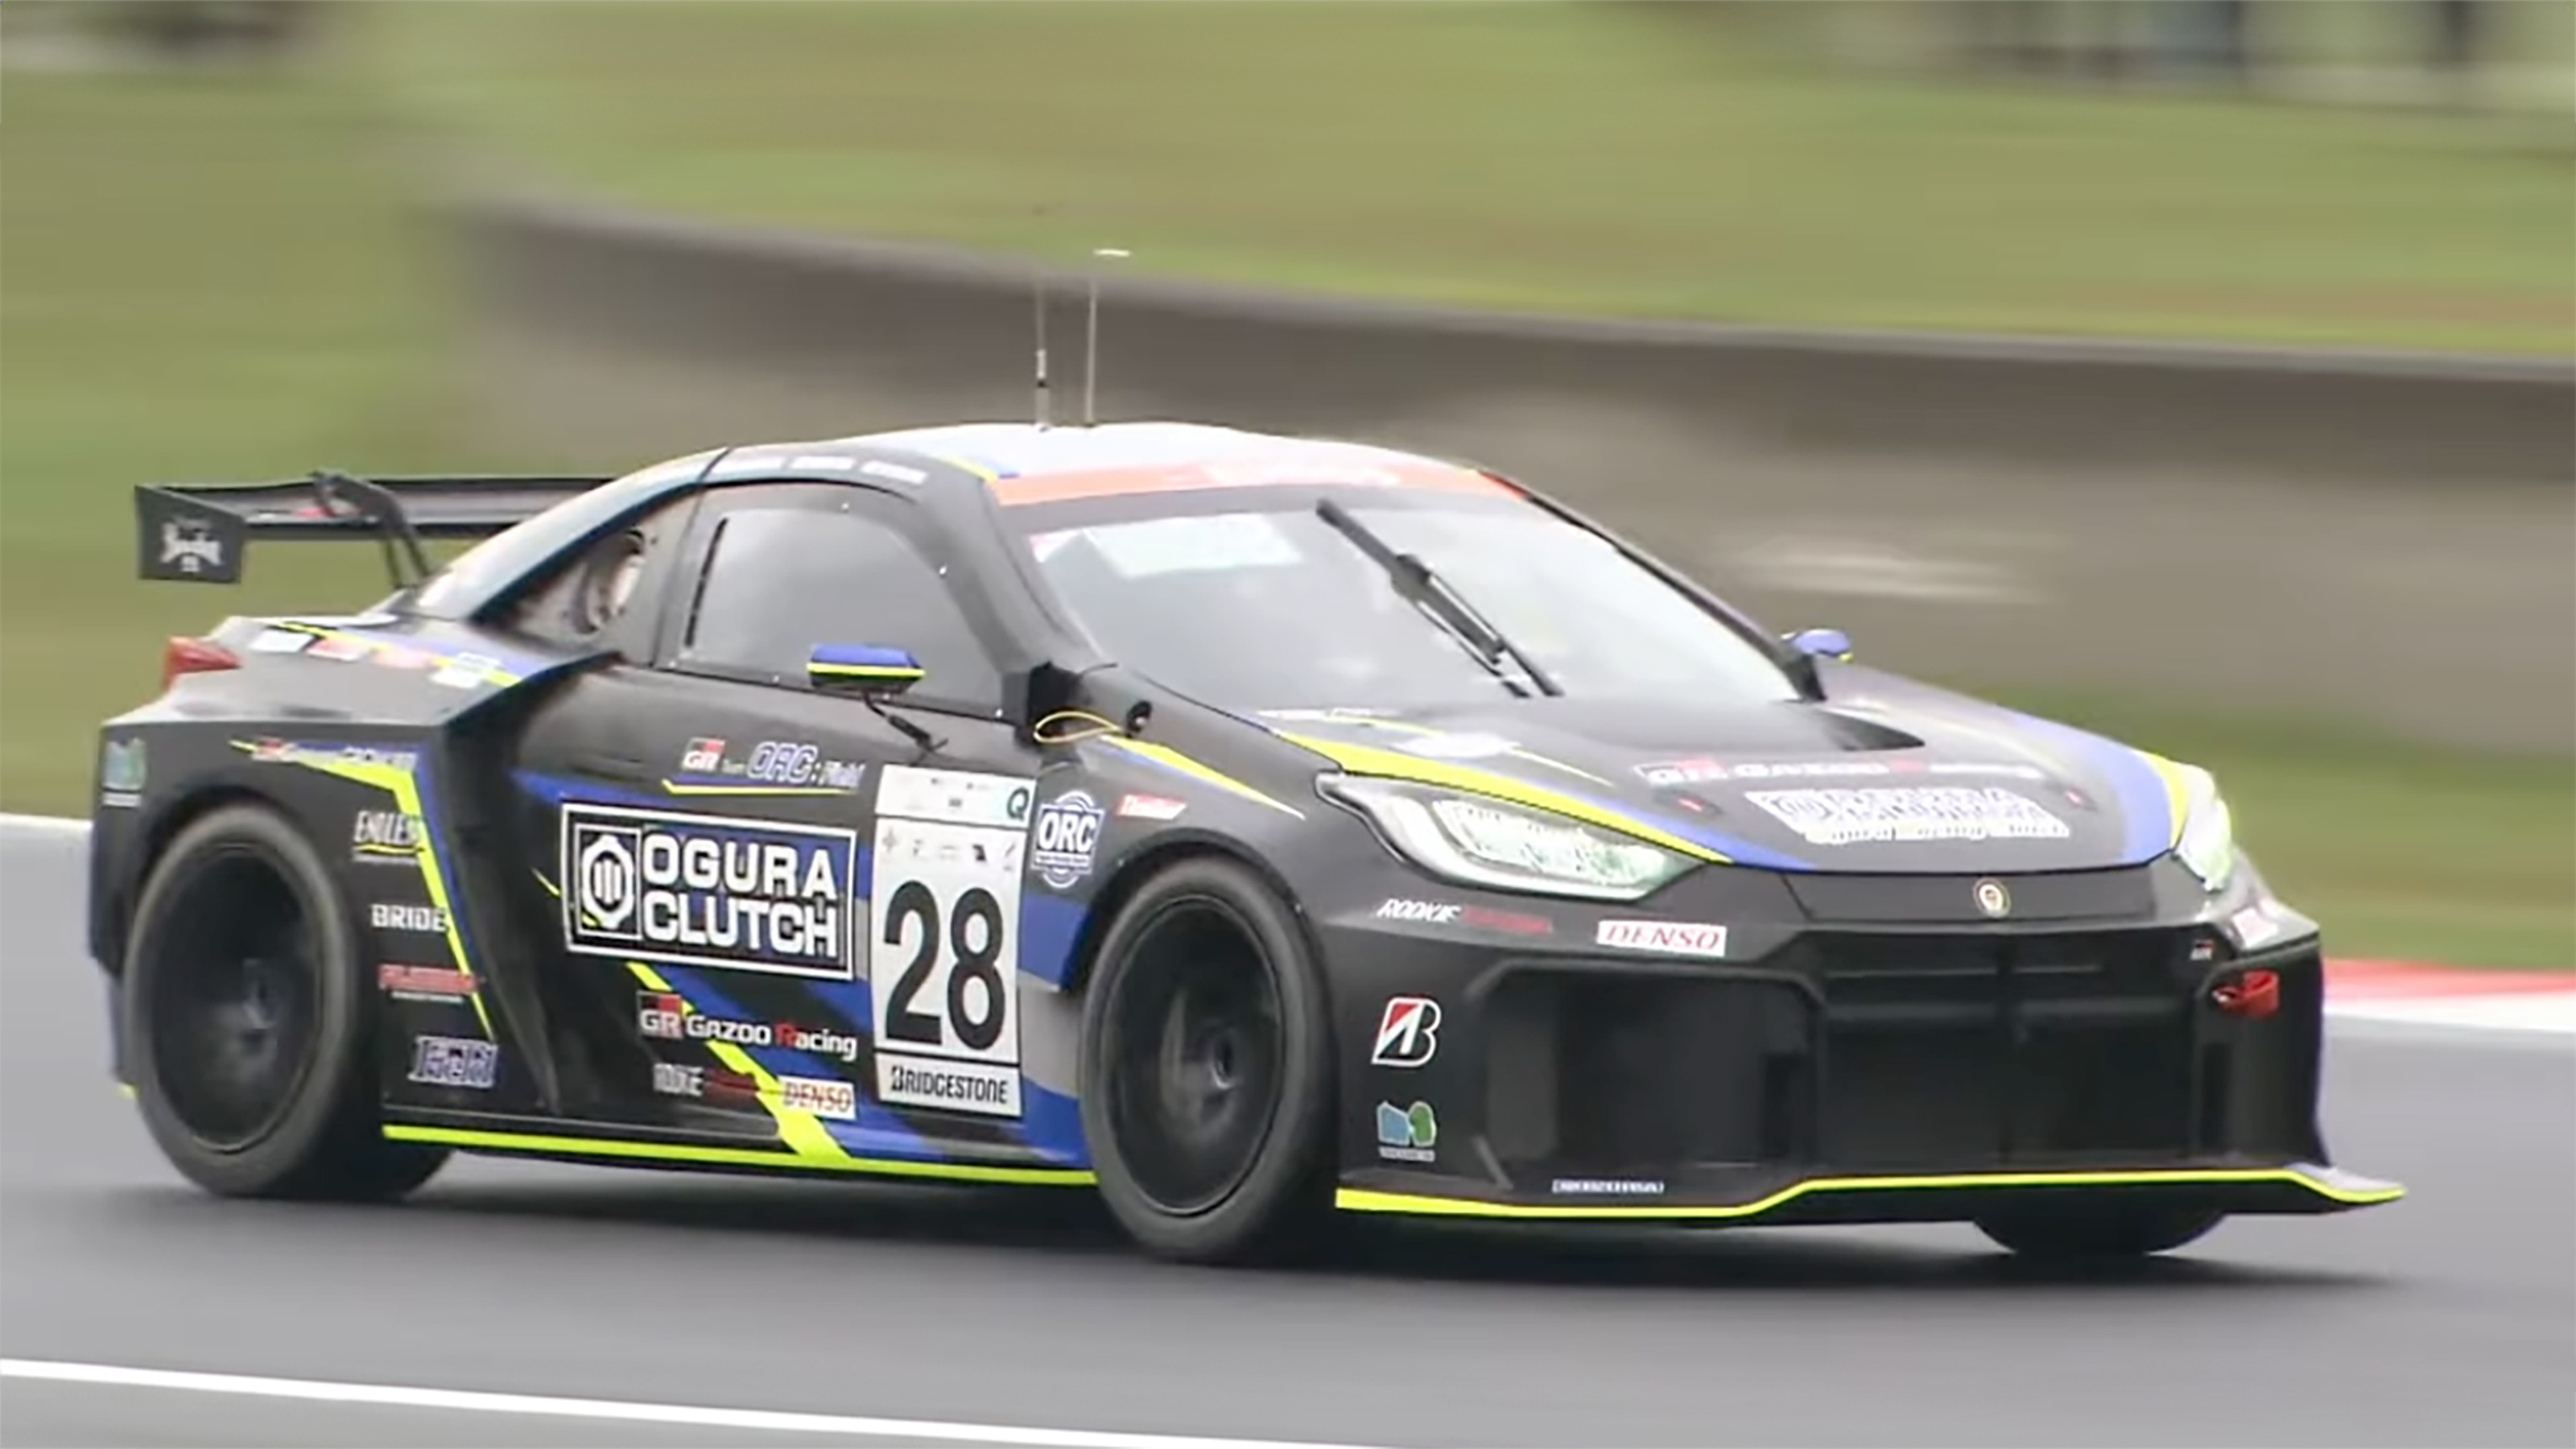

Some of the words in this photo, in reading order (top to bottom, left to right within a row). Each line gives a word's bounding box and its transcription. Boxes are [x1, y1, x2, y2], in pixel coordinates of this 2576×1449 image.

[1006, 786, 1030, 821] Q
[1038, 811, 1096, 852] ORC
[642, 833, 838, 901] OGURA
[371, 903, 448, 933] BRIDE
[642, 890, 838, 958] CLUTCH
[1606, 925, 1720, 951] DENSO
[883, 879, 1006, 1051] 28
[639, 1009, 683, 1038] GR
[686, 1014, 771, 1045] GAZOO
[774, 1021, 857, 1061] Racing
[782, 1081, 852, 1113] DENSO
[891, 1064, 1008, 1104] BRIDGESTONE
